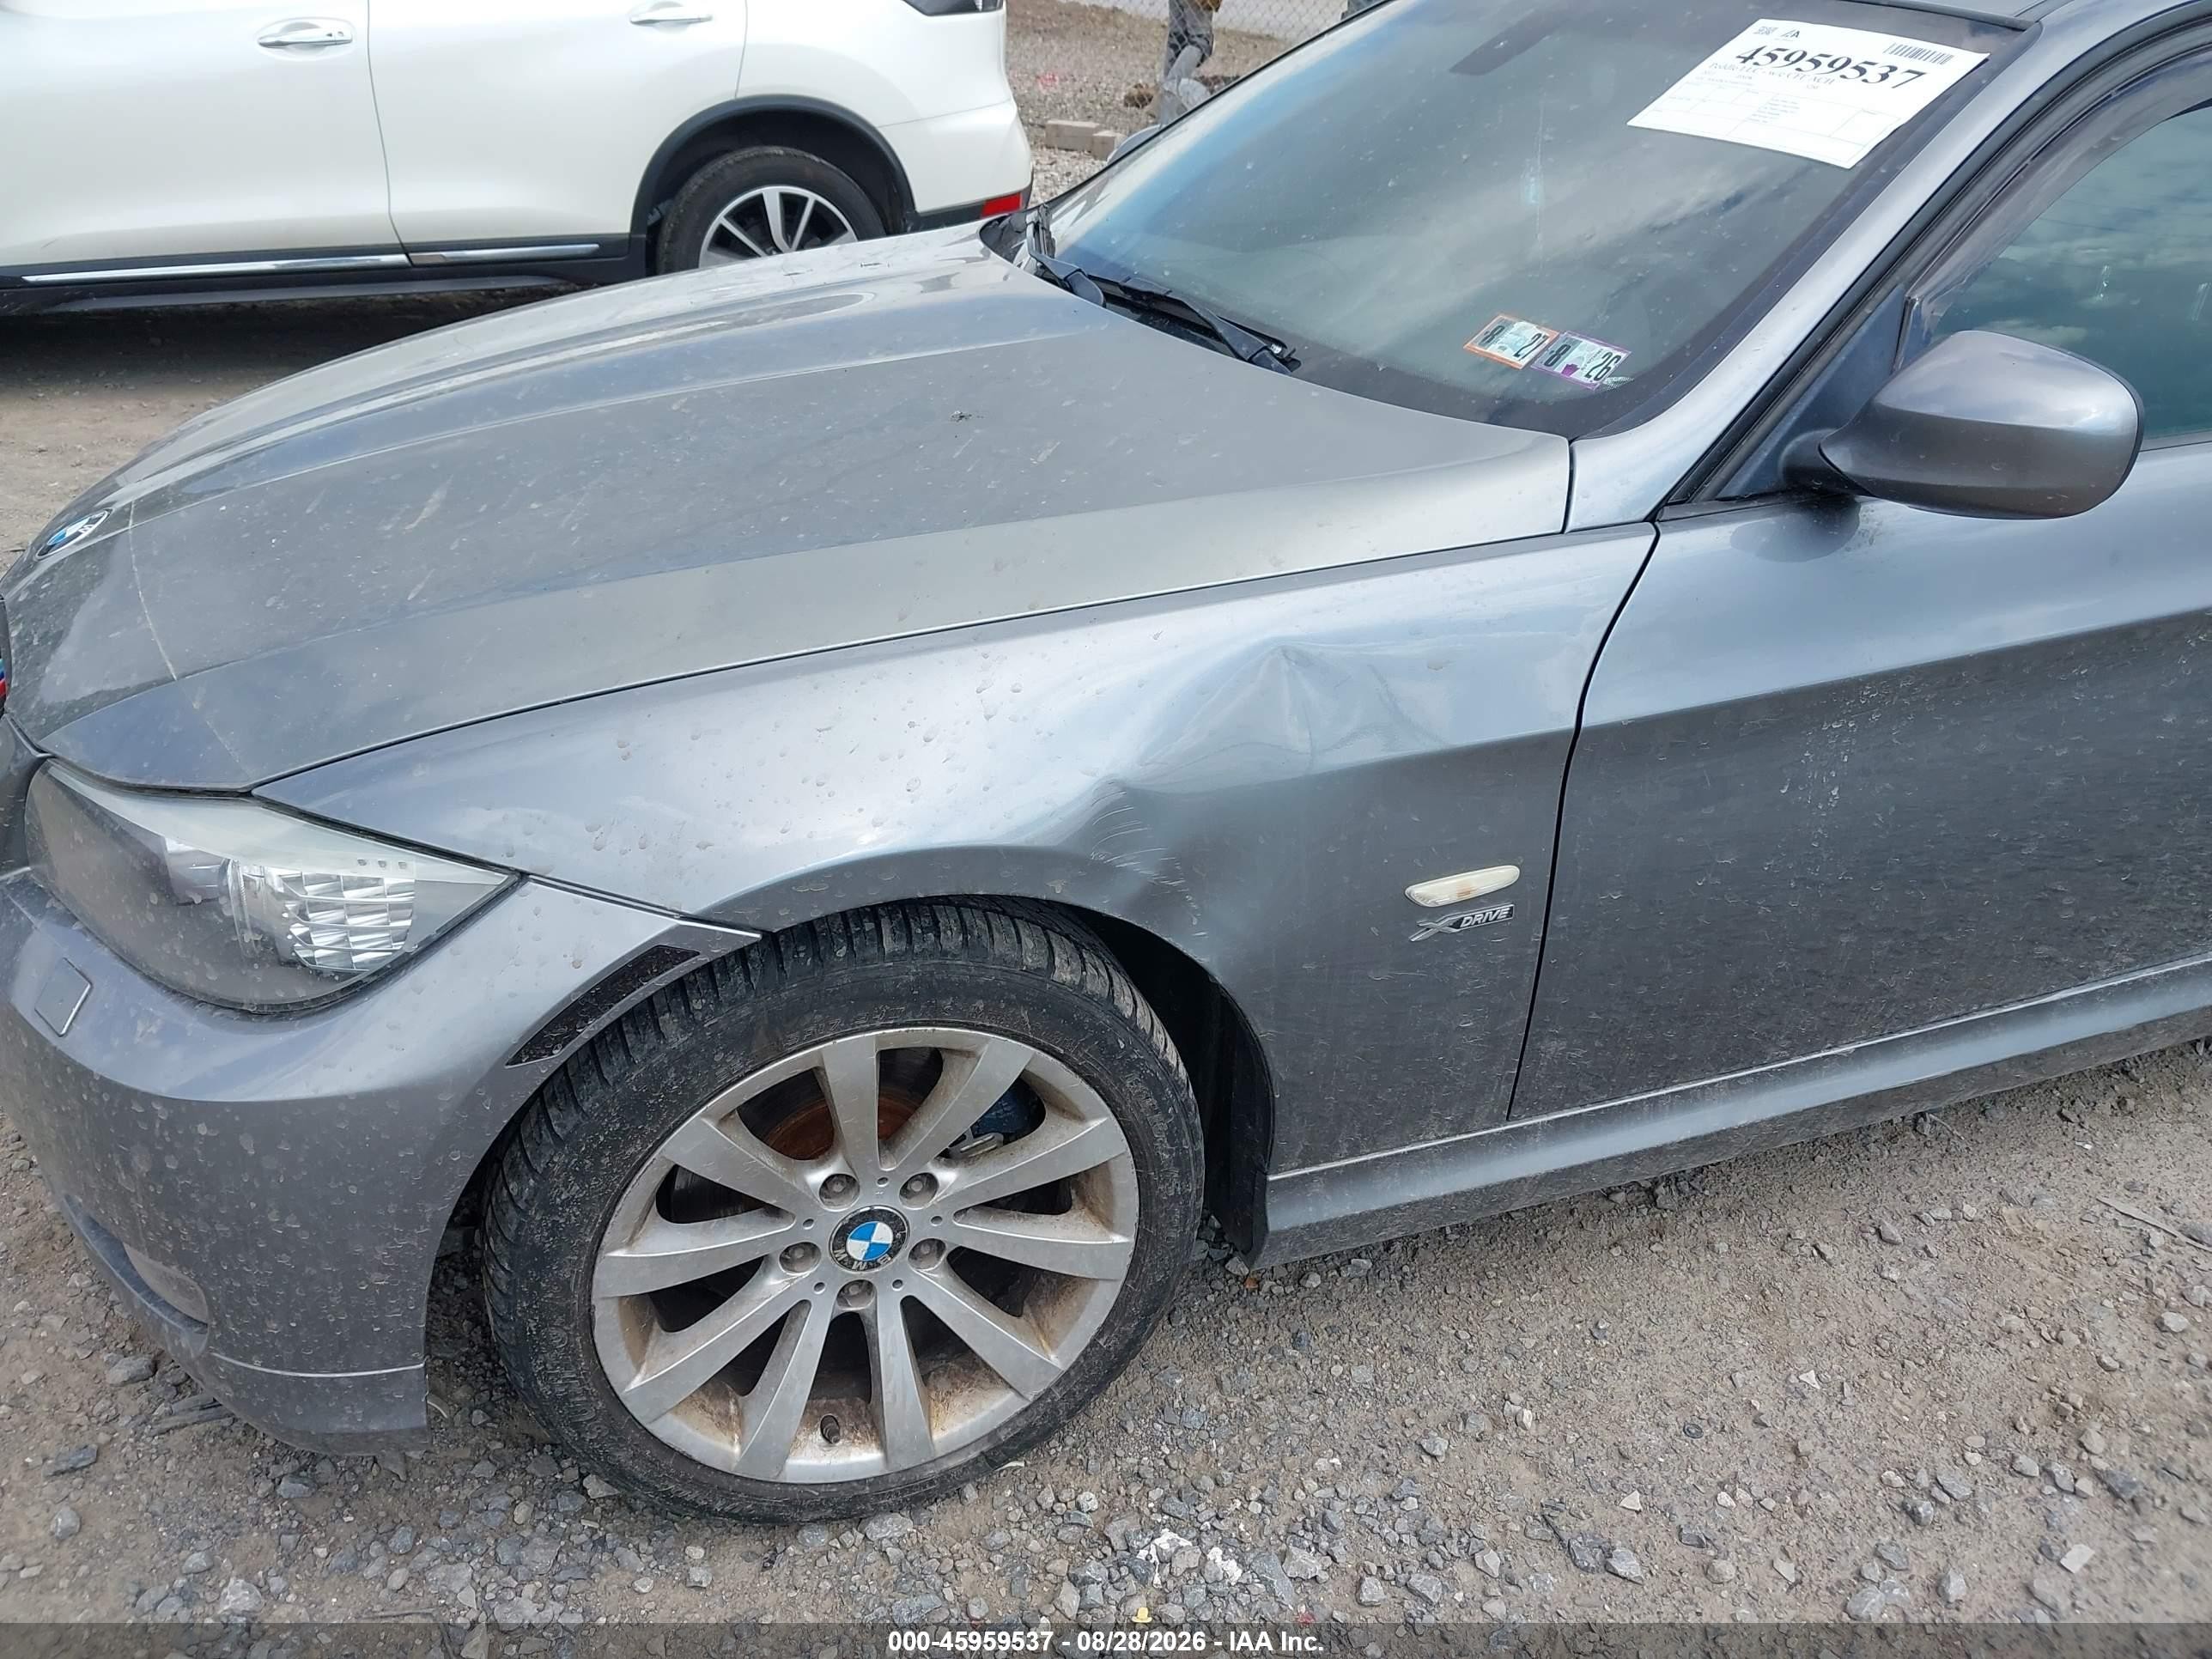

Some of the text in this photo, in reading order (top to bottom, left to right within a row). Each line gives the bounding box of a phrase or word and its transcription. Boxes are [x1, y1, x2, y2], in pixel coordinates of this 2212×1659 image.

[1735, 46, 1928, 88] 45959537
[1513, 332, 1550, 362] 27
[1544, 343, 1571, 368] 8
[1584, 351, 1622, 381] 26
